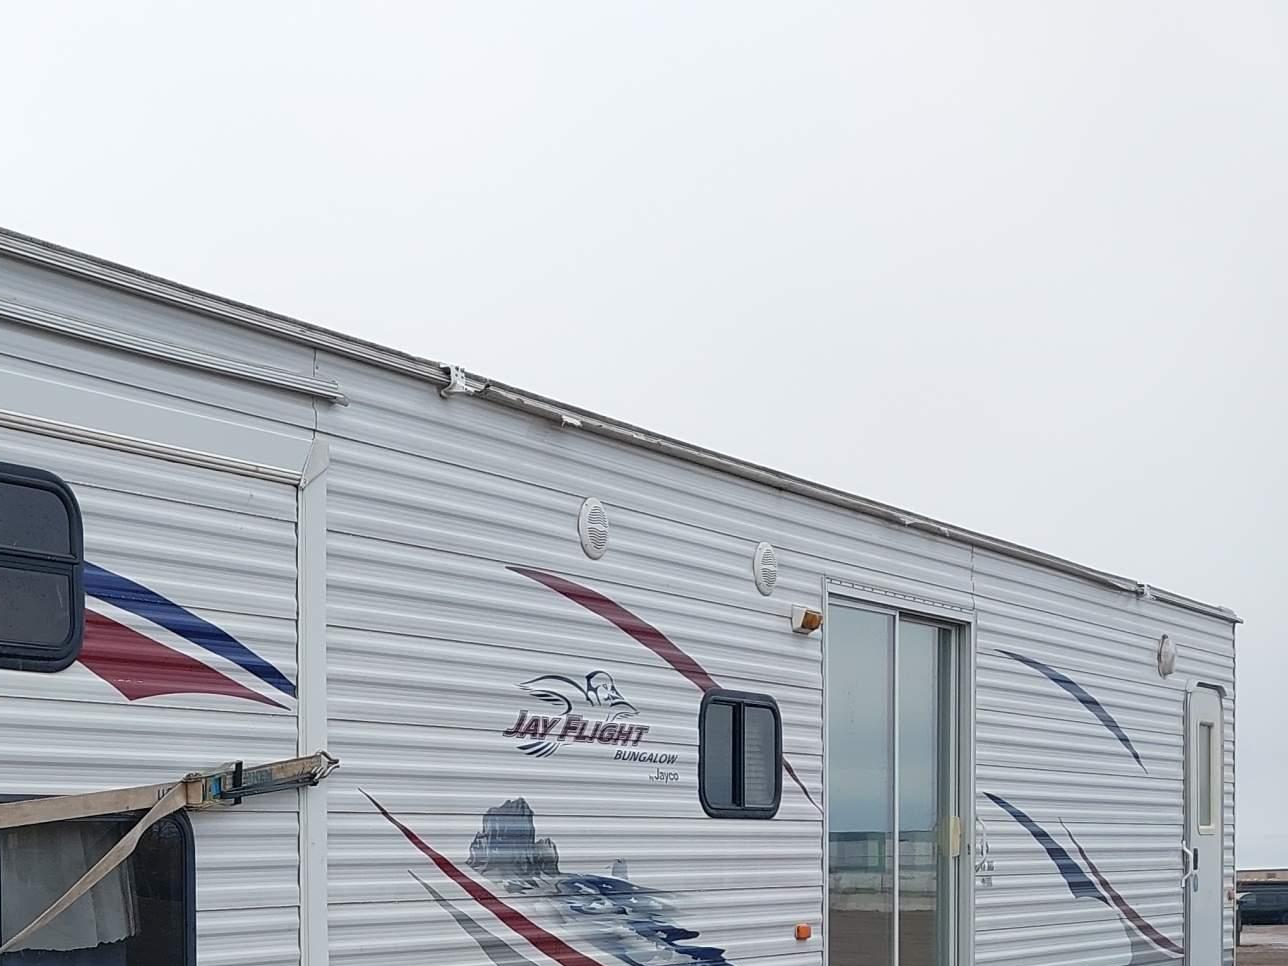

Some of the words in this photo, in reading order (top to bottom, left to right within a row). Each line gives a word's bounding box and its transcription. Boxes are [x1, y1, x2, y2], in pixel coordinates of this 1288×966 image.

[503, 710, 561, 740] JAY
[557, 714, 650, 747] FLIGHT
[614, 750, 679, 765] BUNGALOW
[655, 768, 679, 784] Jayco
